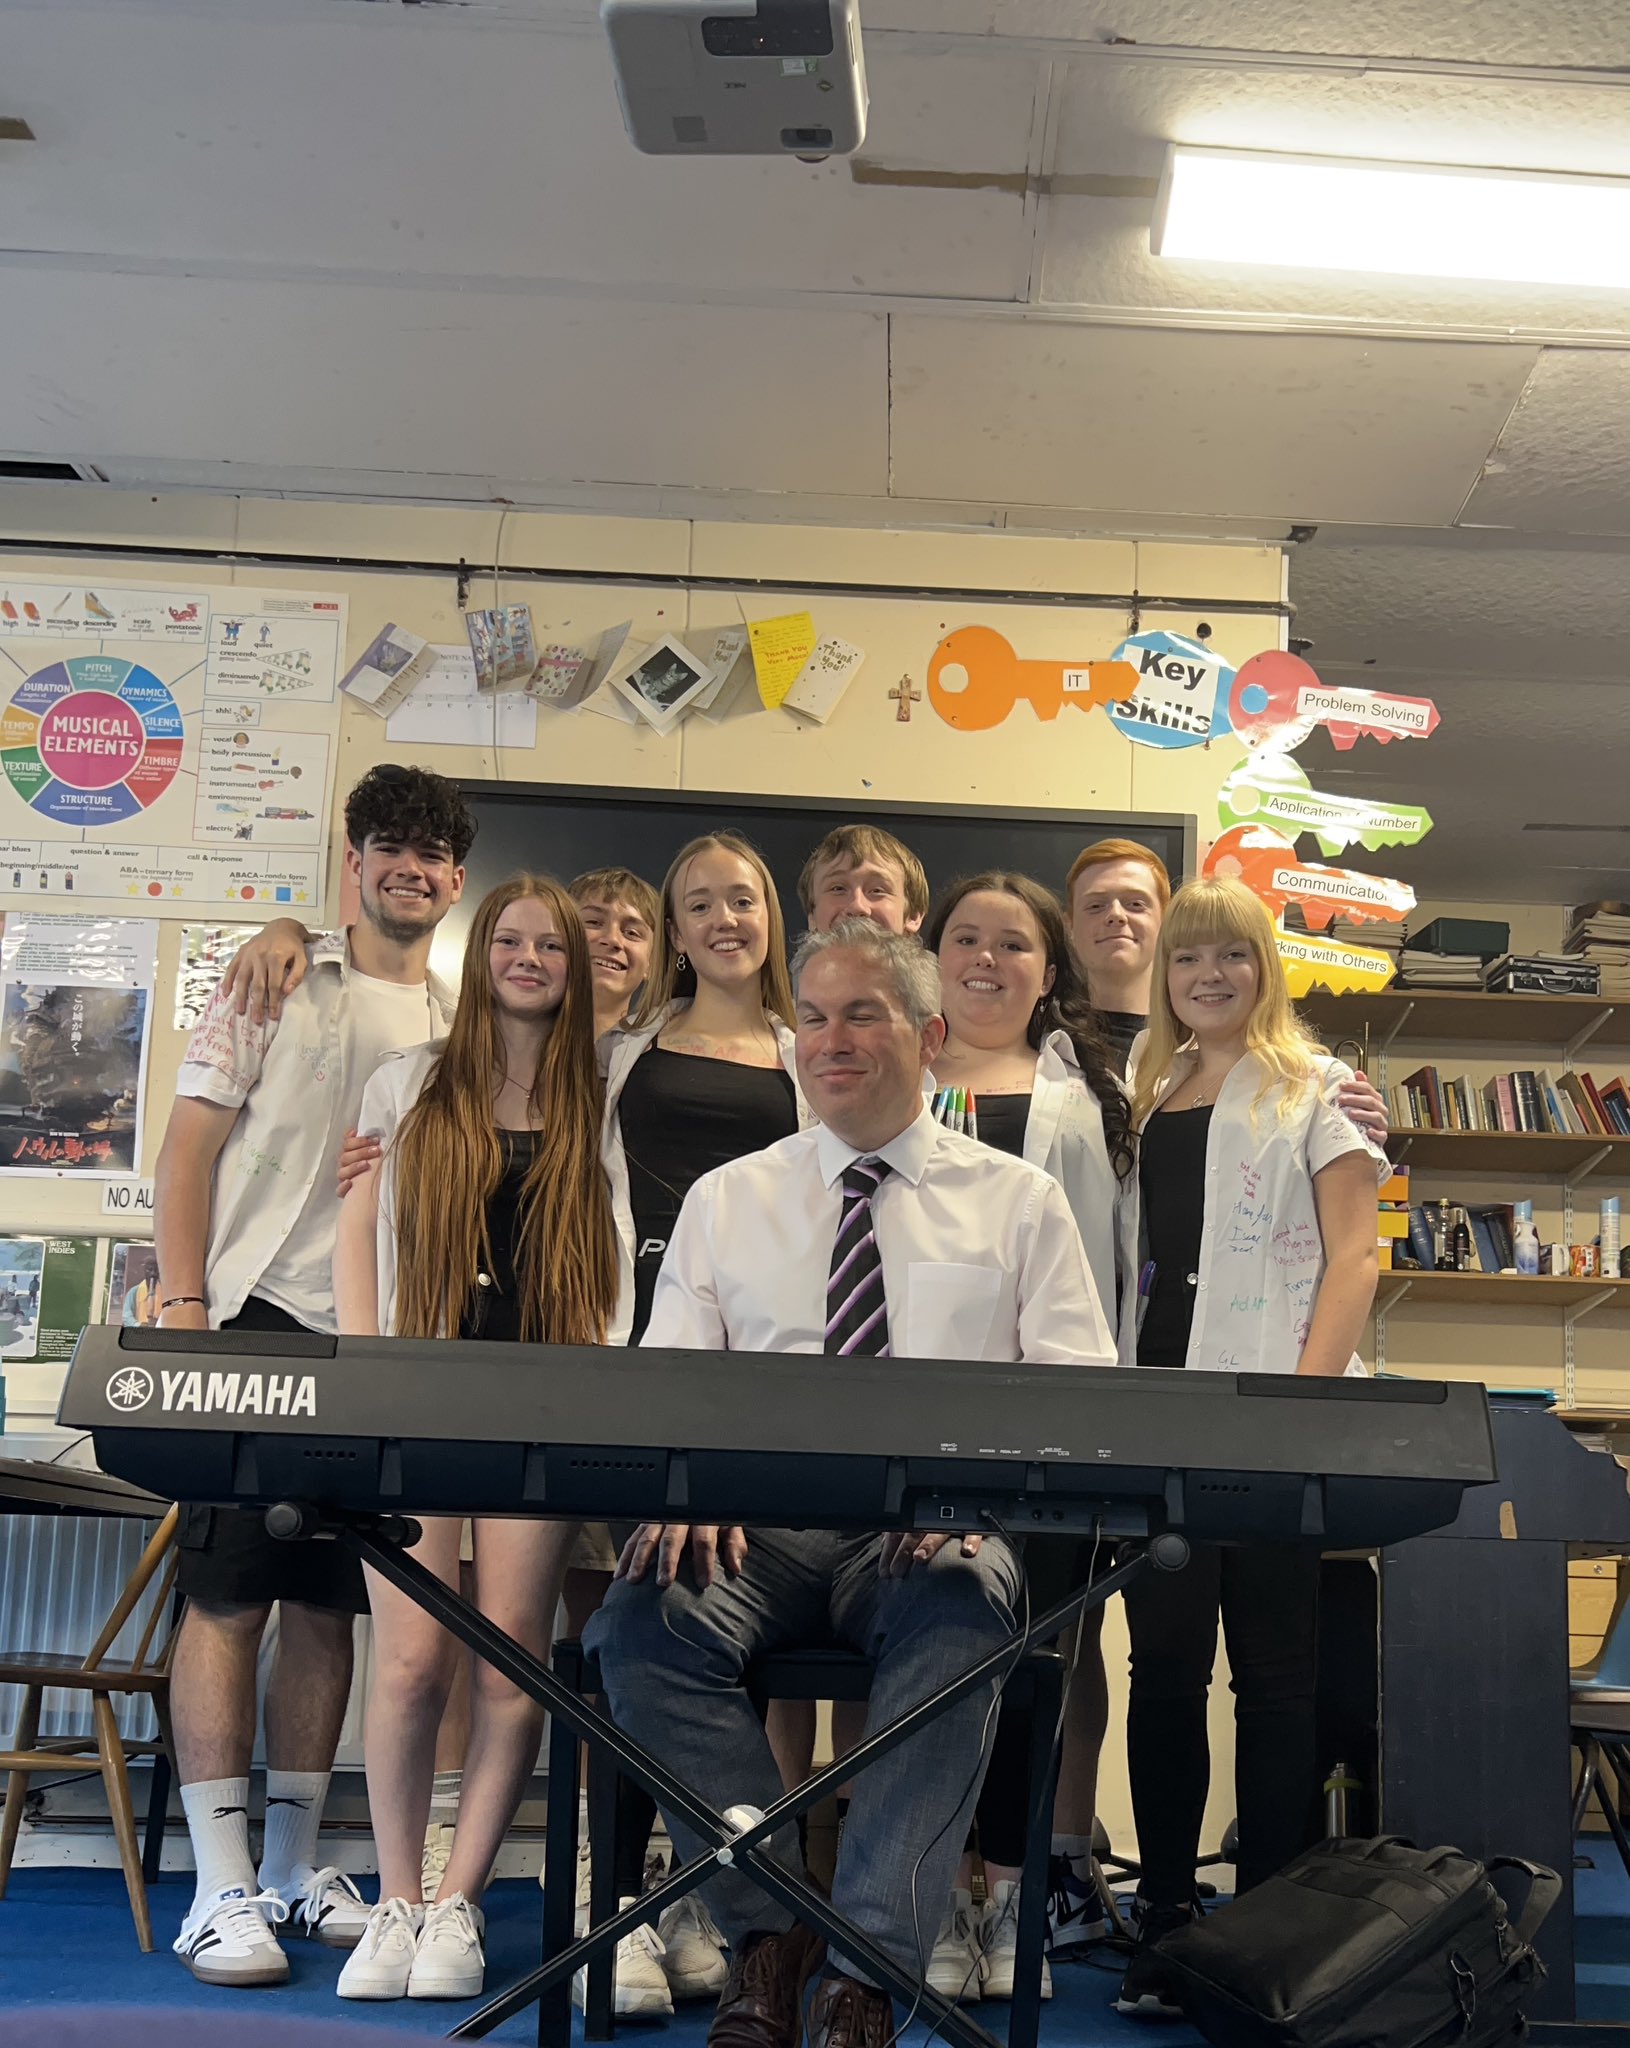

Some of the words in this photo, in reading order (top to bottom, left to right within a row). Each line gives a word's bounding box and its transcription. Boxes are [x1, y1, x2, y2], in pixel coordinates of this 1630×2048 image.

[220, 650, 257, 658] crescendo
[823, 644, 854, 665] Thank
[85, 663, 112, 673] PITCH
[1139, 649, 1206, 691] Key
[1068, 674, 1083, 688] IT
[23, 682, 71, 693] DURATION
[121, 686, 167, 697] DYNAMICS
[1116, 696, 1211, 735] Skills
[1304, 693, 1366, 714] Problem
[1370, 704, 1425, 727] Solving
[53, 715, 133, 738] MUSICAL
[144, 716, 181, 728] SILENCE
[44, 736, 139, 756] ELEMENTS
[211, 749, 230, 757] body
[232, 750, 271, 758] percussion
[5, 761, 42, 772] TEXTURE
[144, 756, 179, 766] TIMBRE
[209, 780, 257, 788] instrumental
[60, 794, 113, 805] STRUCTURE
[208, 794, 262, 802] environmental
[1269, 797, 1342, 817] Application
[70, 848, 102, 856] question
[174, 869, 194, 877] form
[1311, 947, 1338, 962] with
[1342, 953, 1387, 973] Others
[107, 1187, 130, 1208] NO
[49, 1240, 73, 1248] WEST
[160, 1370, 316, 1417] YAMAHA
